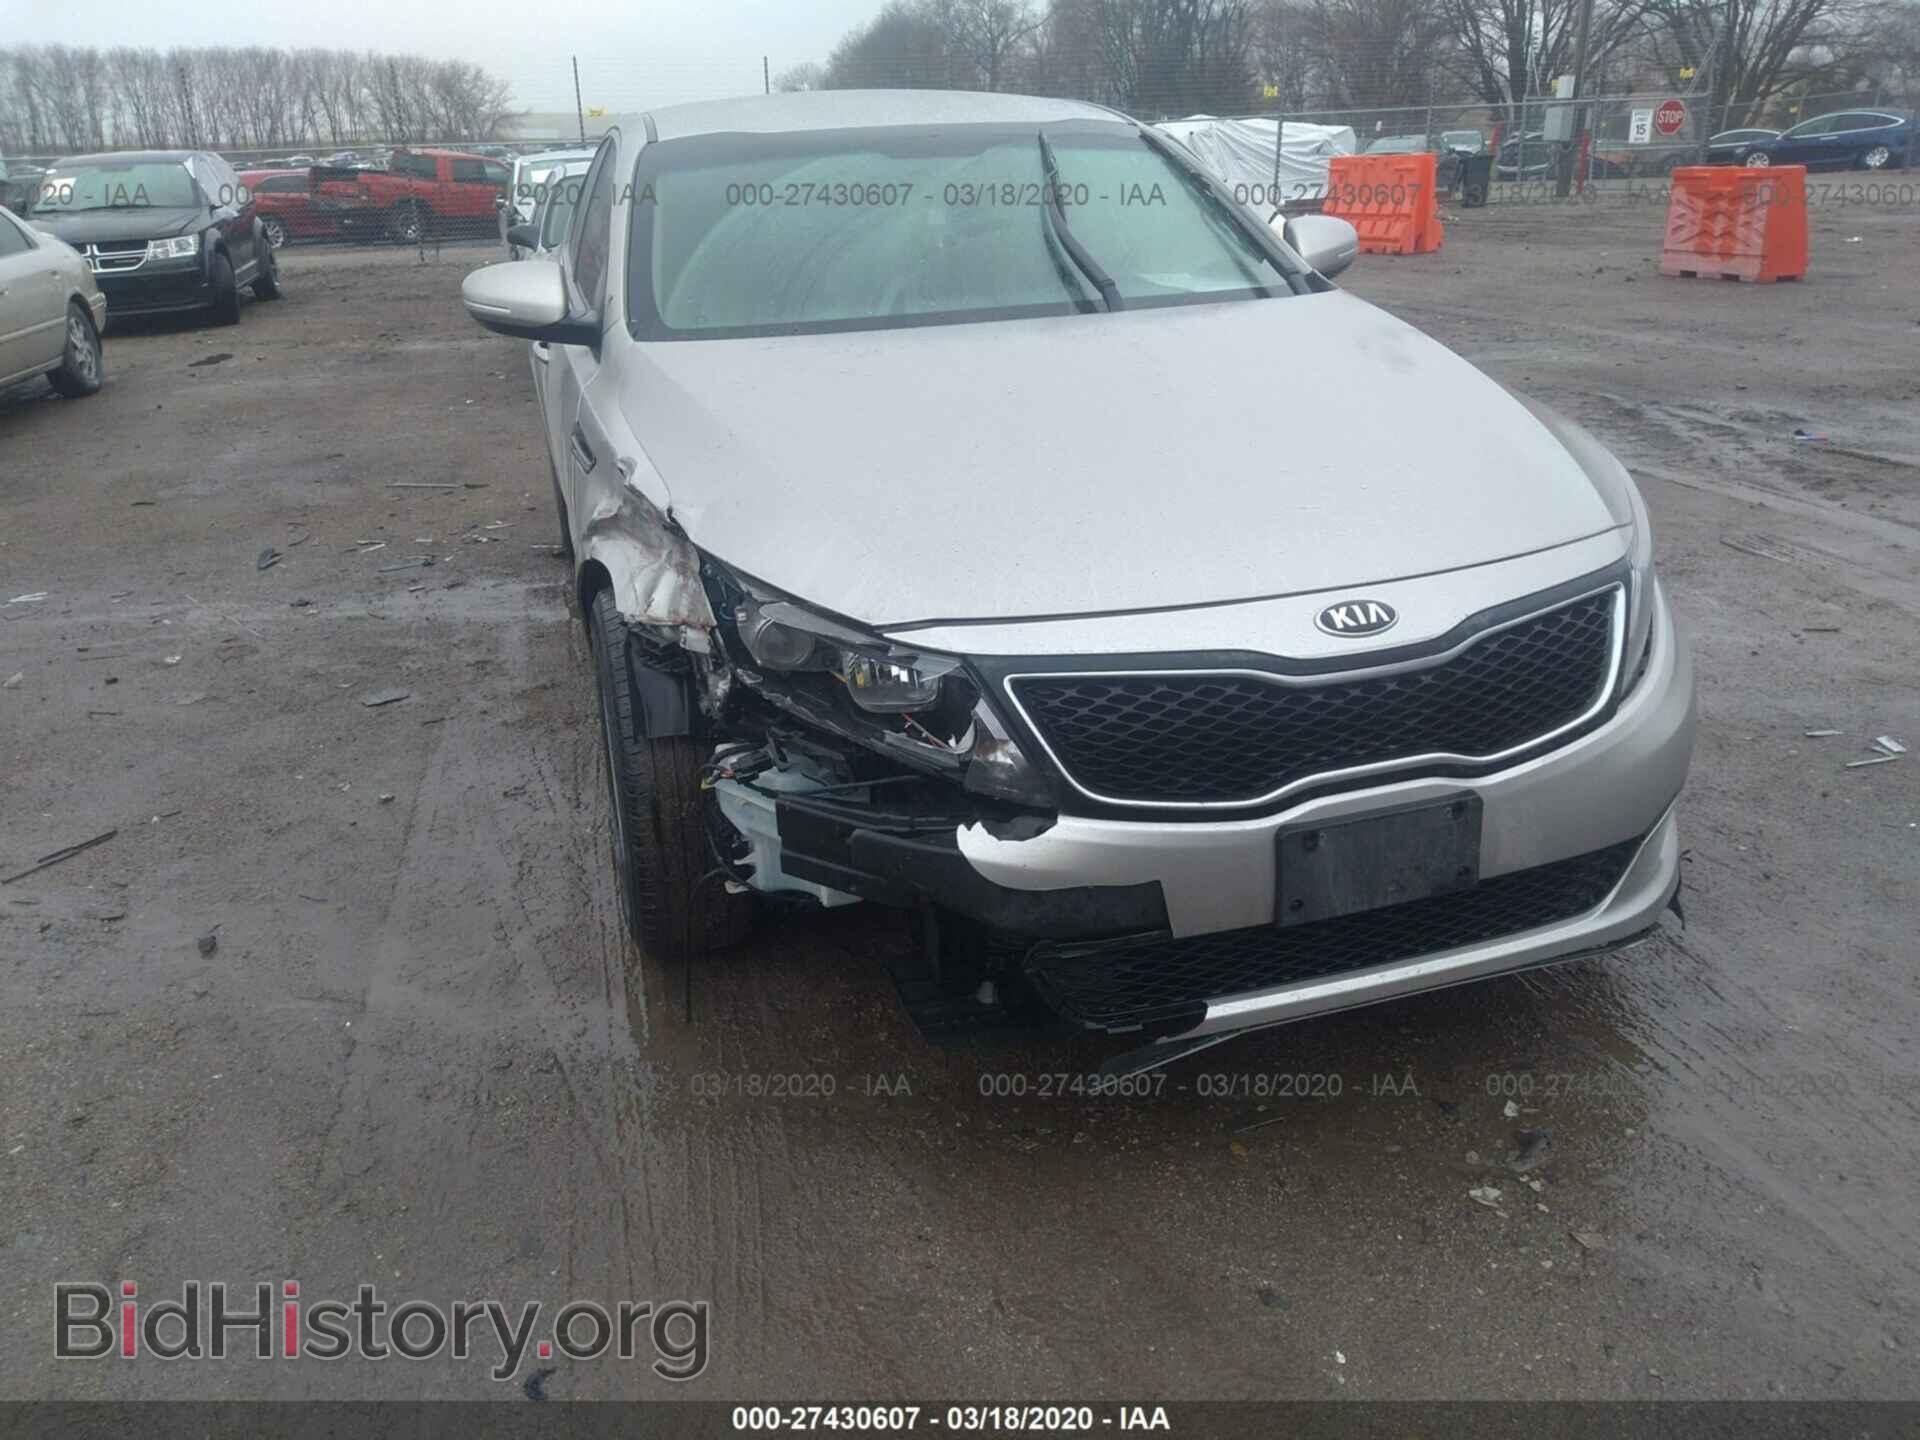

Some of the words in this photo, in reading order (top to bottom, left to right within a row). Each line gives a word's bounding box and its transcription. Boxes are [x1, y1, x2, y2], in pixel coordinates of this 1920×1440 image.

[1658, 110, 1684, 123] STOP
[1636, 124, 1646, 136] 15
[1327, 602, 1391, 629] KIA
